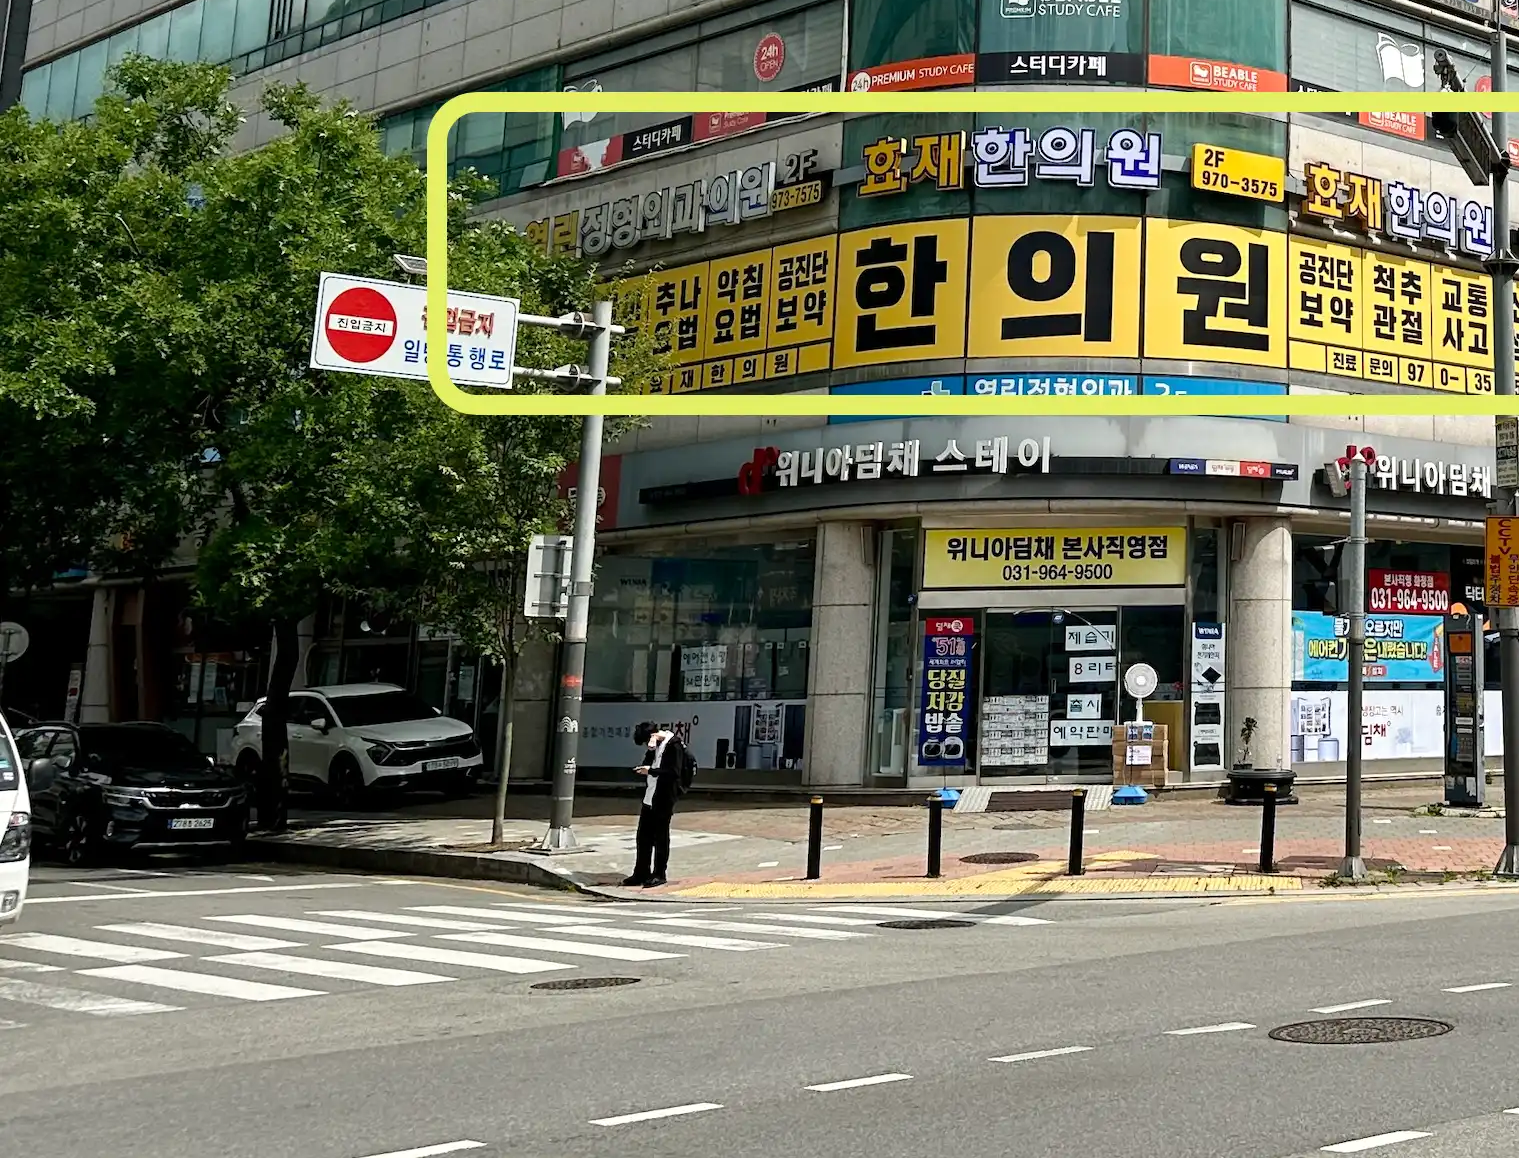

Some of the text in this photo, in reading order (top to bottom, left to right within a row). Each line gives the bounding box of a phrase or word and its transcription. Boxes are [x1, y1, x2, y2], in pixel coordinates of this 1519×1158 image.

[1038, 4, 1120, 17] STUDY CAFE
[761, 44, 779, 60] 24h
[872, 69, 915, 86] PREMIUM
[919, 65, 948, 79] STUDY
[949, 63, 974, 75] CAFE
[1010, 56, 1107, 77] 스터디카페
[1213, 65, 1258, 83] BEABLE
[1213, 78, 1237, 91] STUDY
[632, 123, 682, 153] 스터디카페
[784, 149, 818, 184] 2F
[857, 125, 1163, 198] 효재한의원
[1204, 149, 1225, 166] 2F
[772, 185, 821, 211] 973-7575
[1202, 171, 1278, 198] 970-3575
[526, 162, 776, 258] 열린정형외과의원
[1303, 162, 1495, 258] 효재한의원
[717, 262, 763, 304] 약침
[778, 250, 829, 292] 공진단
[1299, 249, 1354, 292] 공진단
[1373, 263, 1423, 305] 척추
[656, 276, 701, 317] 추나
[855, 230, 1269, 352] 한의원
[1442, 278, 1488, 318] 교통
[713, 303, 761, 344] 요법
[776, 290, 827, 333] 보약
[1299, 290, 1354, 333] 보약
[1373, 304, 1424, 346] 관절
[337, 316, 388, 335] 진입금지
[652, 314, 698, 355] 요법
[1442, 318, 1489, 357] 사고
[1333, 352, 1394, 379] 진료 문의
[776, 436, 1051, 487] 위니아딤채 스테이
[1377, 455, 1493, 499] 위니아딤채
[947, 535, 1168, 562] 위니아딤채 본사직영점
[1498, 519, 1513, 555] CCTV
[1002, 563, 1113, 582] 031-964-9500
[1371, 587, 1448, 612] 031-964-9500
[1068, 630, 1115, 645] 제습기
[1365, 619, 1404, 639] 오르지만
[1308, 639, 1339, 659] 에어컨
[1376, 641, 1427, 661] 내렸습니다!
[927, 669, 966, 690] 당질
[1074, 661, 1117, 676] 8 리터
[926, 691, 965, 712] 저감
[924, 712, 964, 734] 밥솥
[1362, 723, 1388, 746] 딤채
